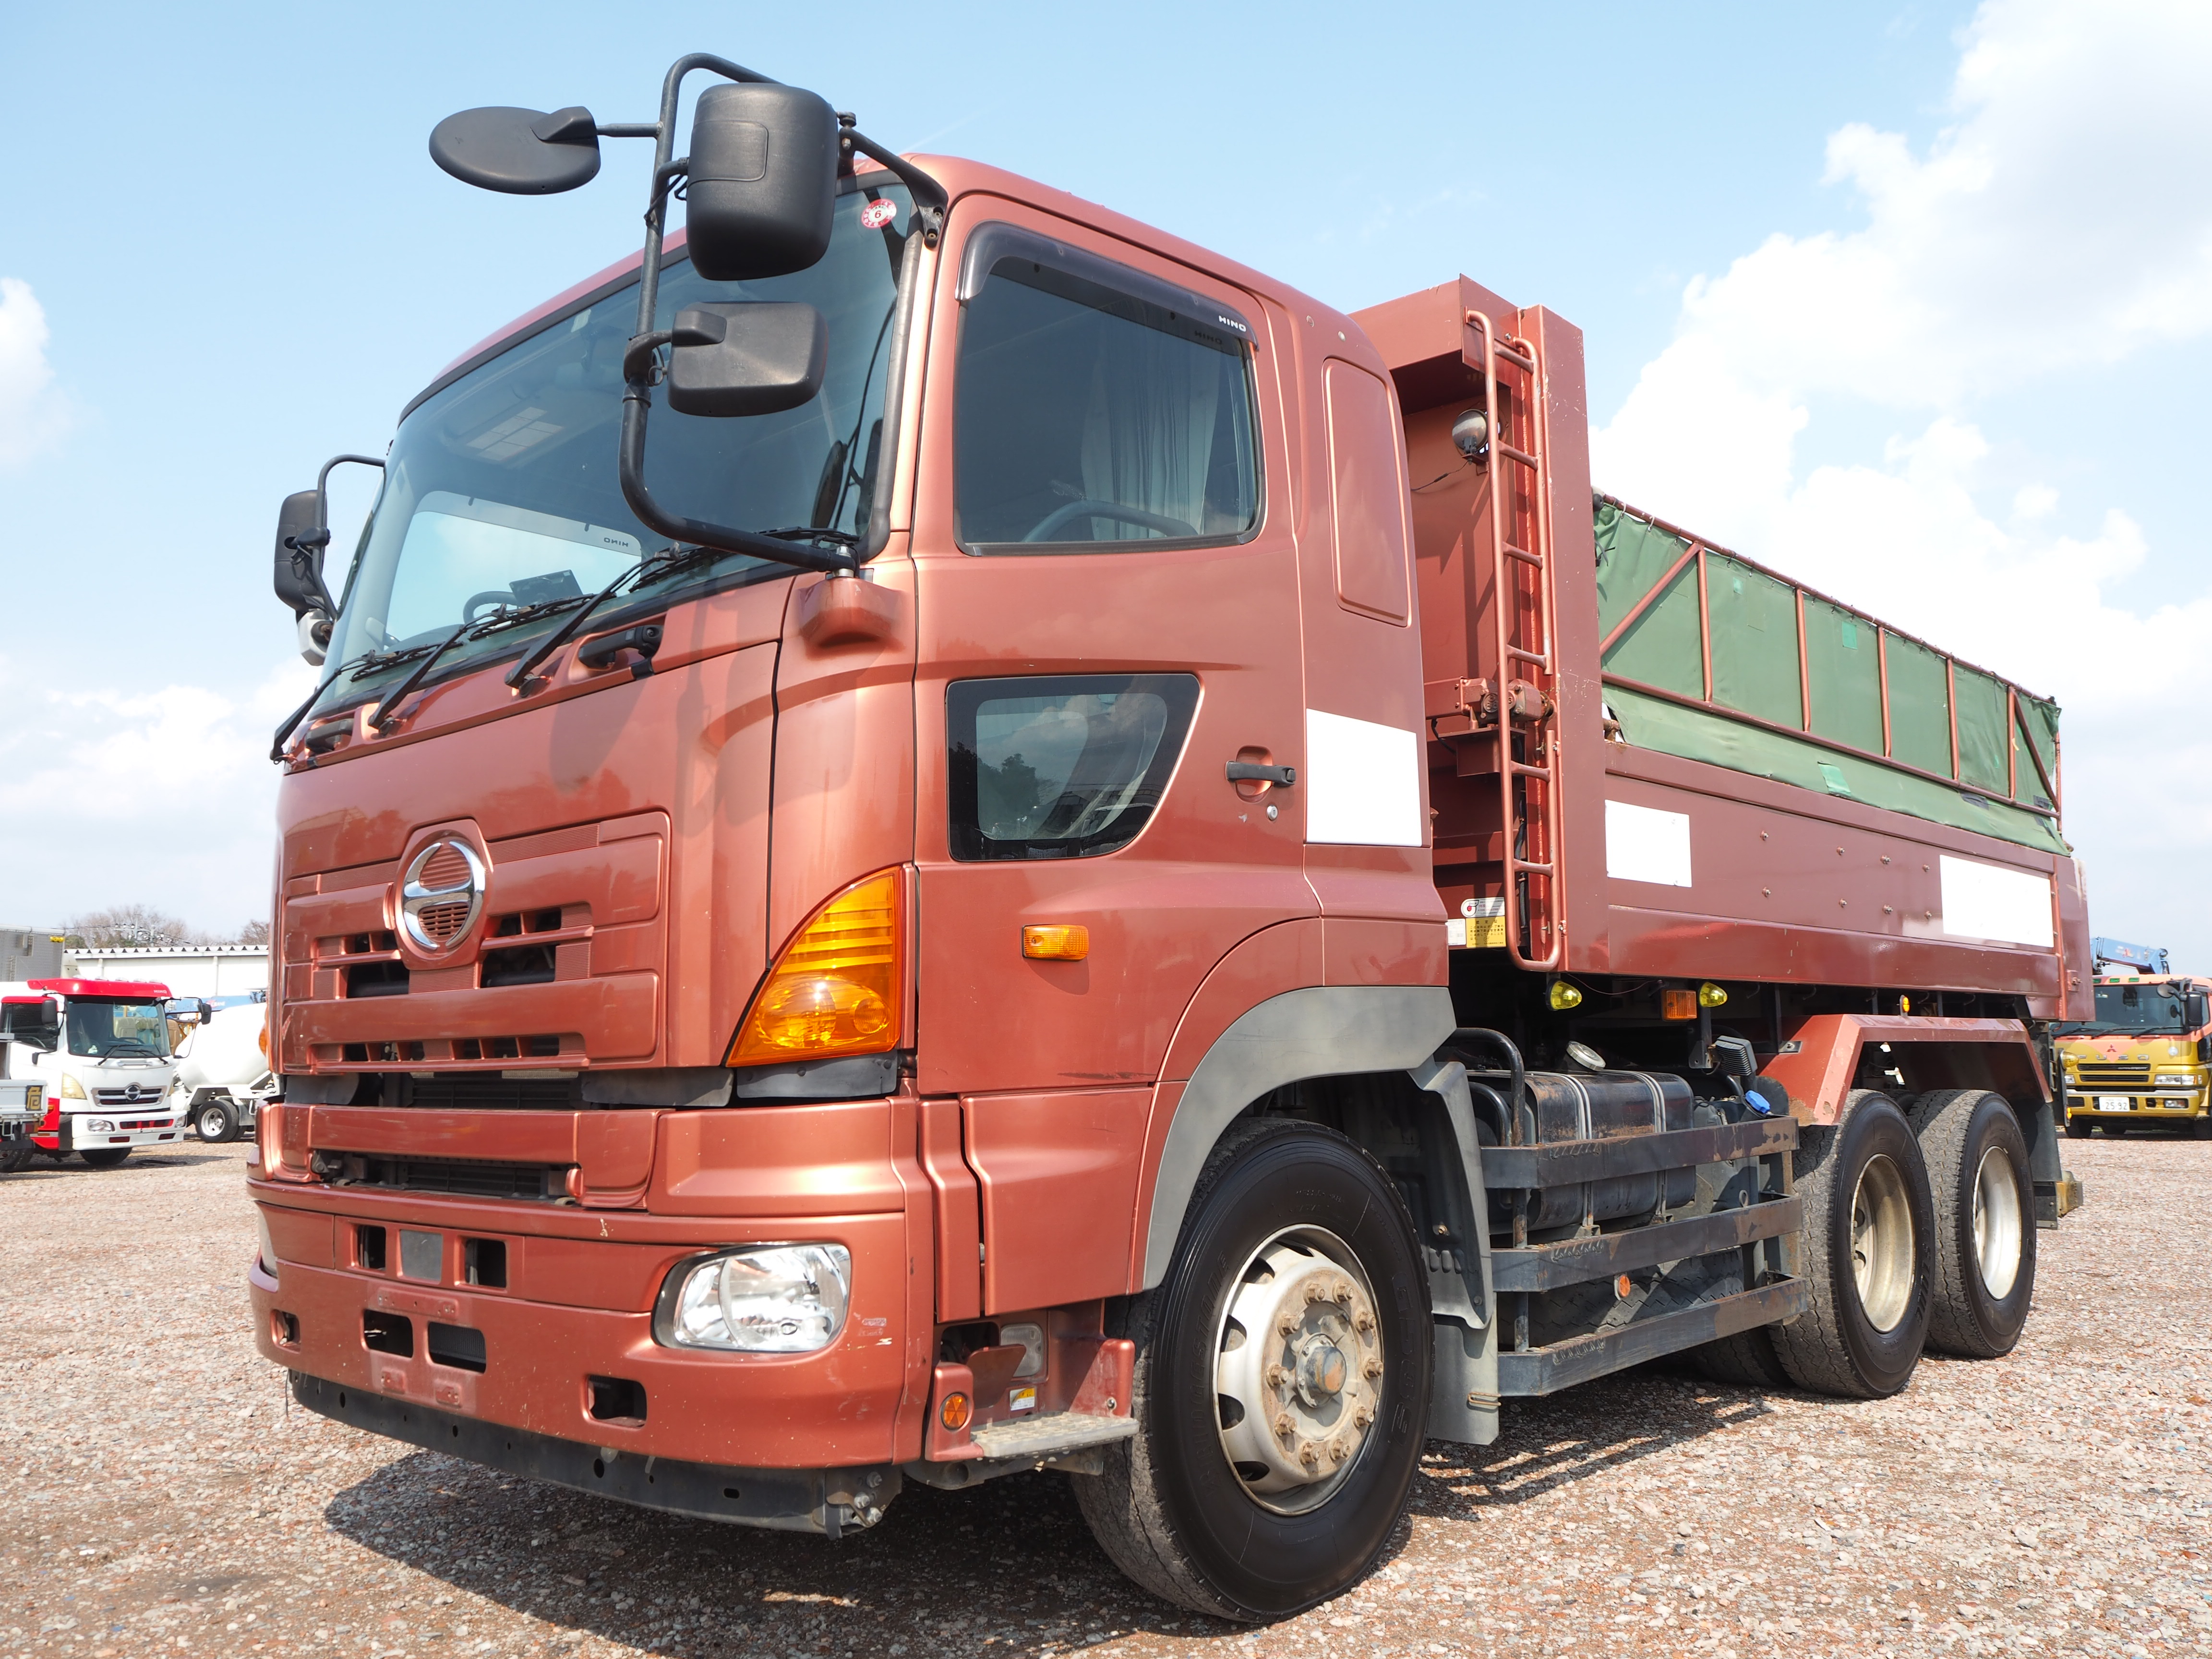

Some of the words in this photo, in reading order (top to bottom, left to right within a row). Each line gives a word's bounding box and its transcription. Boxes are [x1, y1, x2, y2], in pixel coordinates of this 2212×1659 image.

[875, 210, 881, 218] 6
[1218, 315, 1247, 332] HINO
[27, 1087, 42, 1110] 危
[1188, 1250, 1231, 1498] BRIDGESTONE
